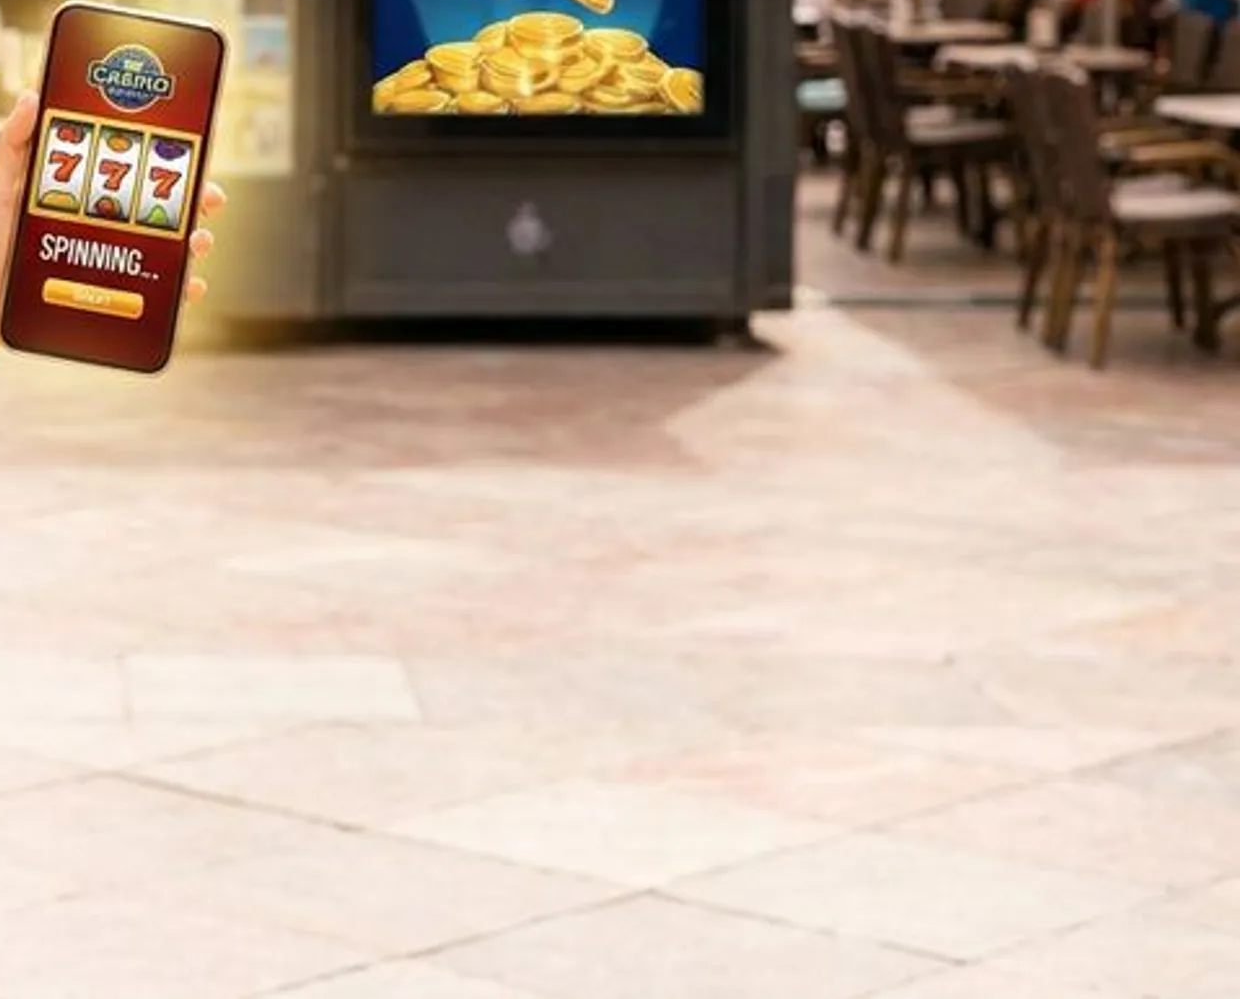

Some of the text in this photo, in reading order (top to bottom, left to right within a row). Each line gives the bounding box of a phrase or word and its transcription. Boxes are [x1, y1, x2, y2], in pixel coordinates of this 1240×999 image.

[49, 150, 182, 199] 7 7 7
